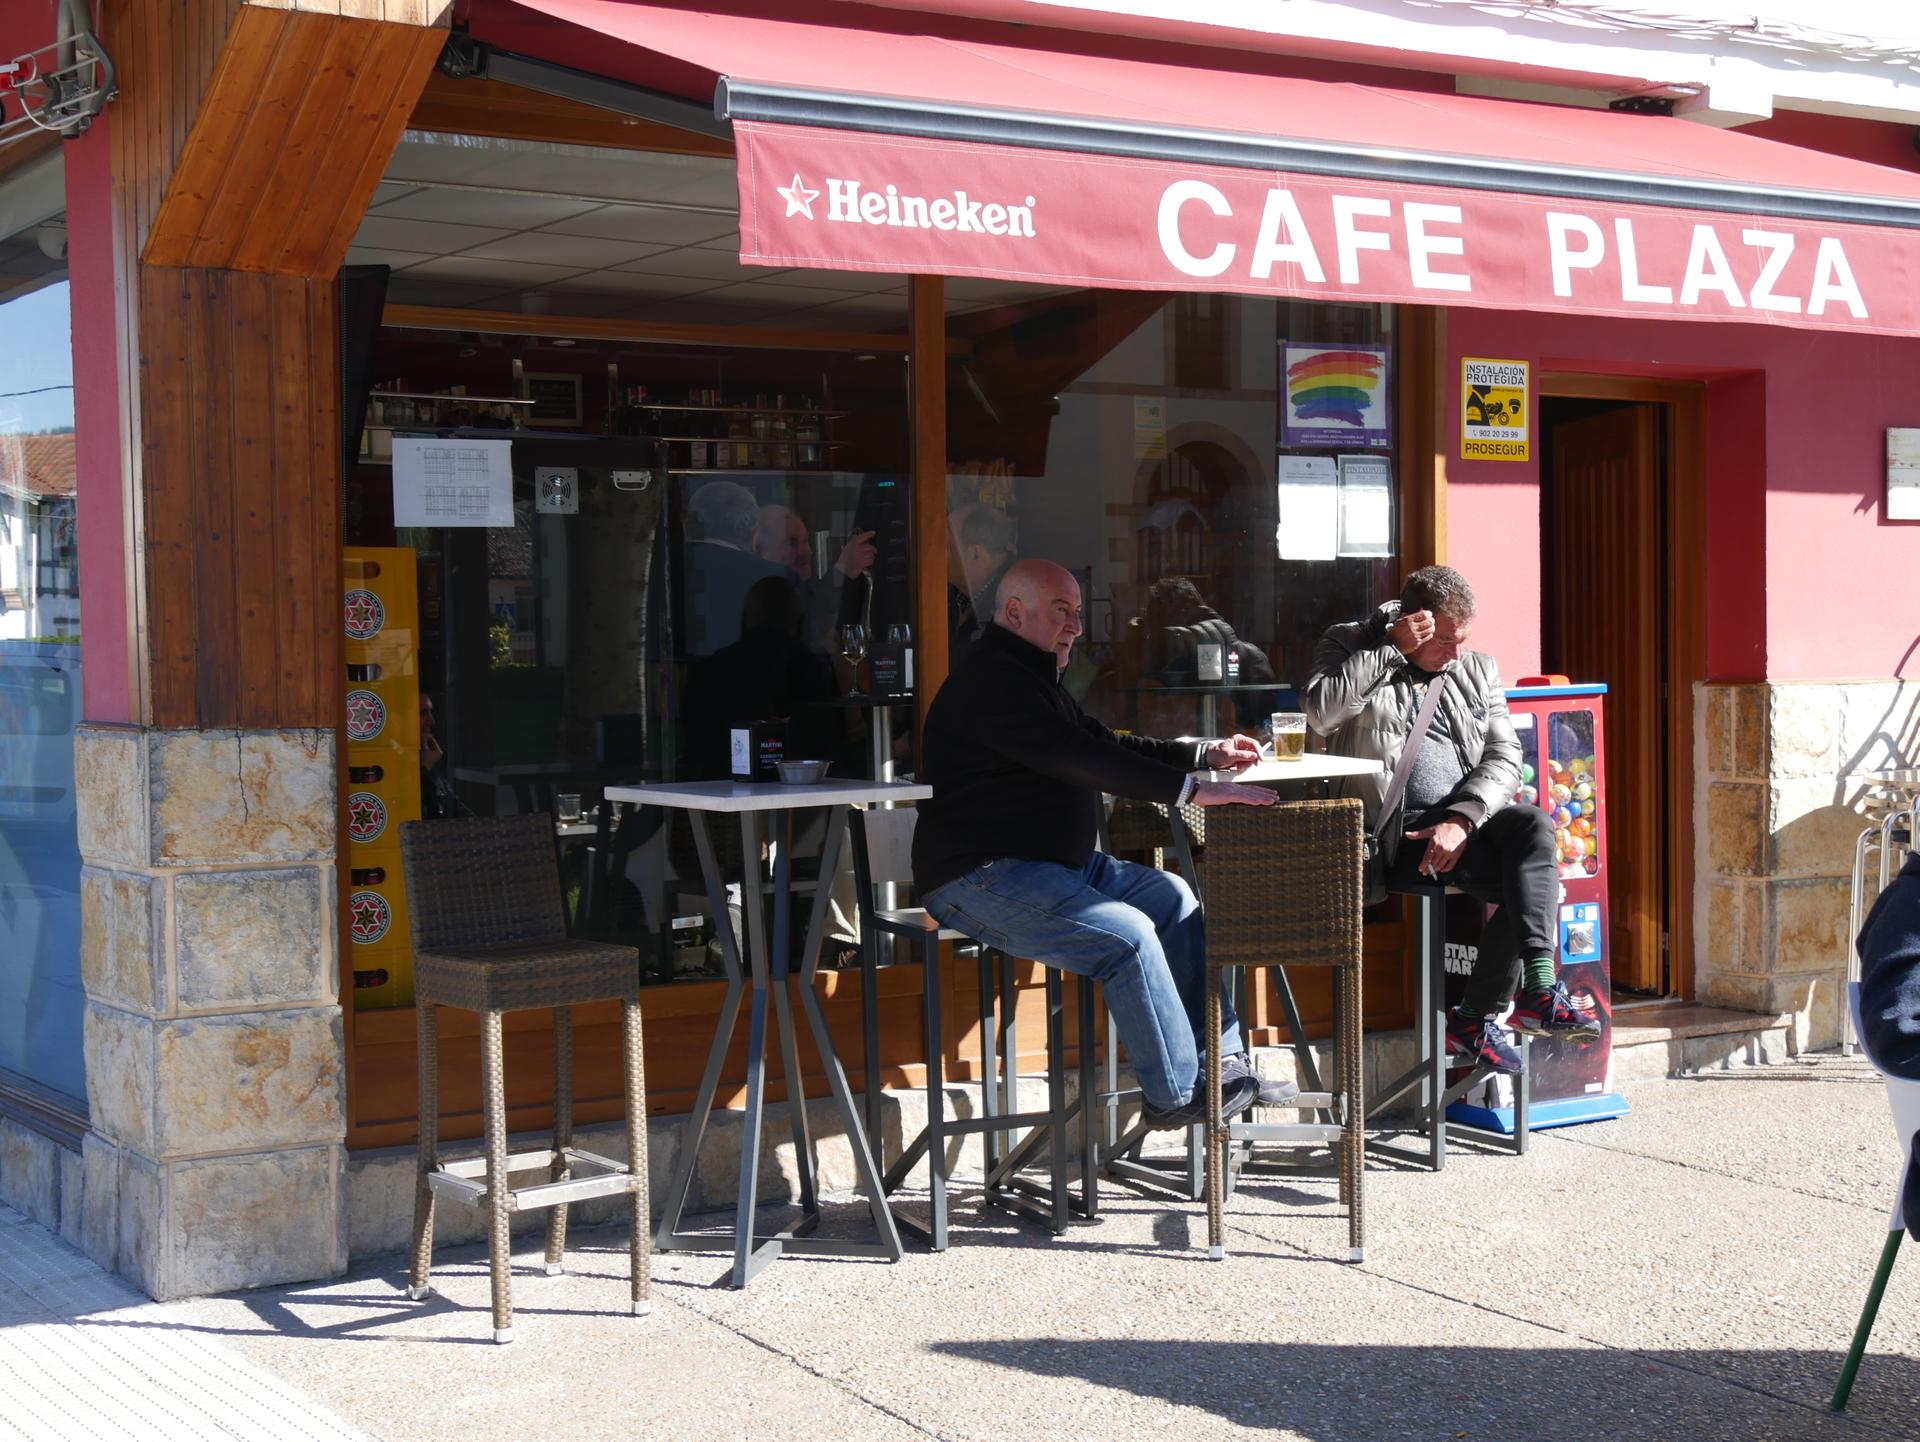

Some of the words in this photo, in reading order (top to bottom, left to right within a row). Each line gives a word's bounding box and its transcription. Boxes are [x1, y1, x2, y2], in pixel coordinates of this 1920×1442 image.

[1157, 178, 1472, 293] CAFE
[1545, 210, 1870, 319] PLAZA
[1466, 373, 1525, 386] PROTEGIDA
[1479, 429, 1491, 438] 902
[1492, 430, 1500, 438] 20
[1501, 430, 1510, 439] 29
[1510, 431, 1519, 439] 99
[1465, 442, 1525, 456] PROSEGUR
